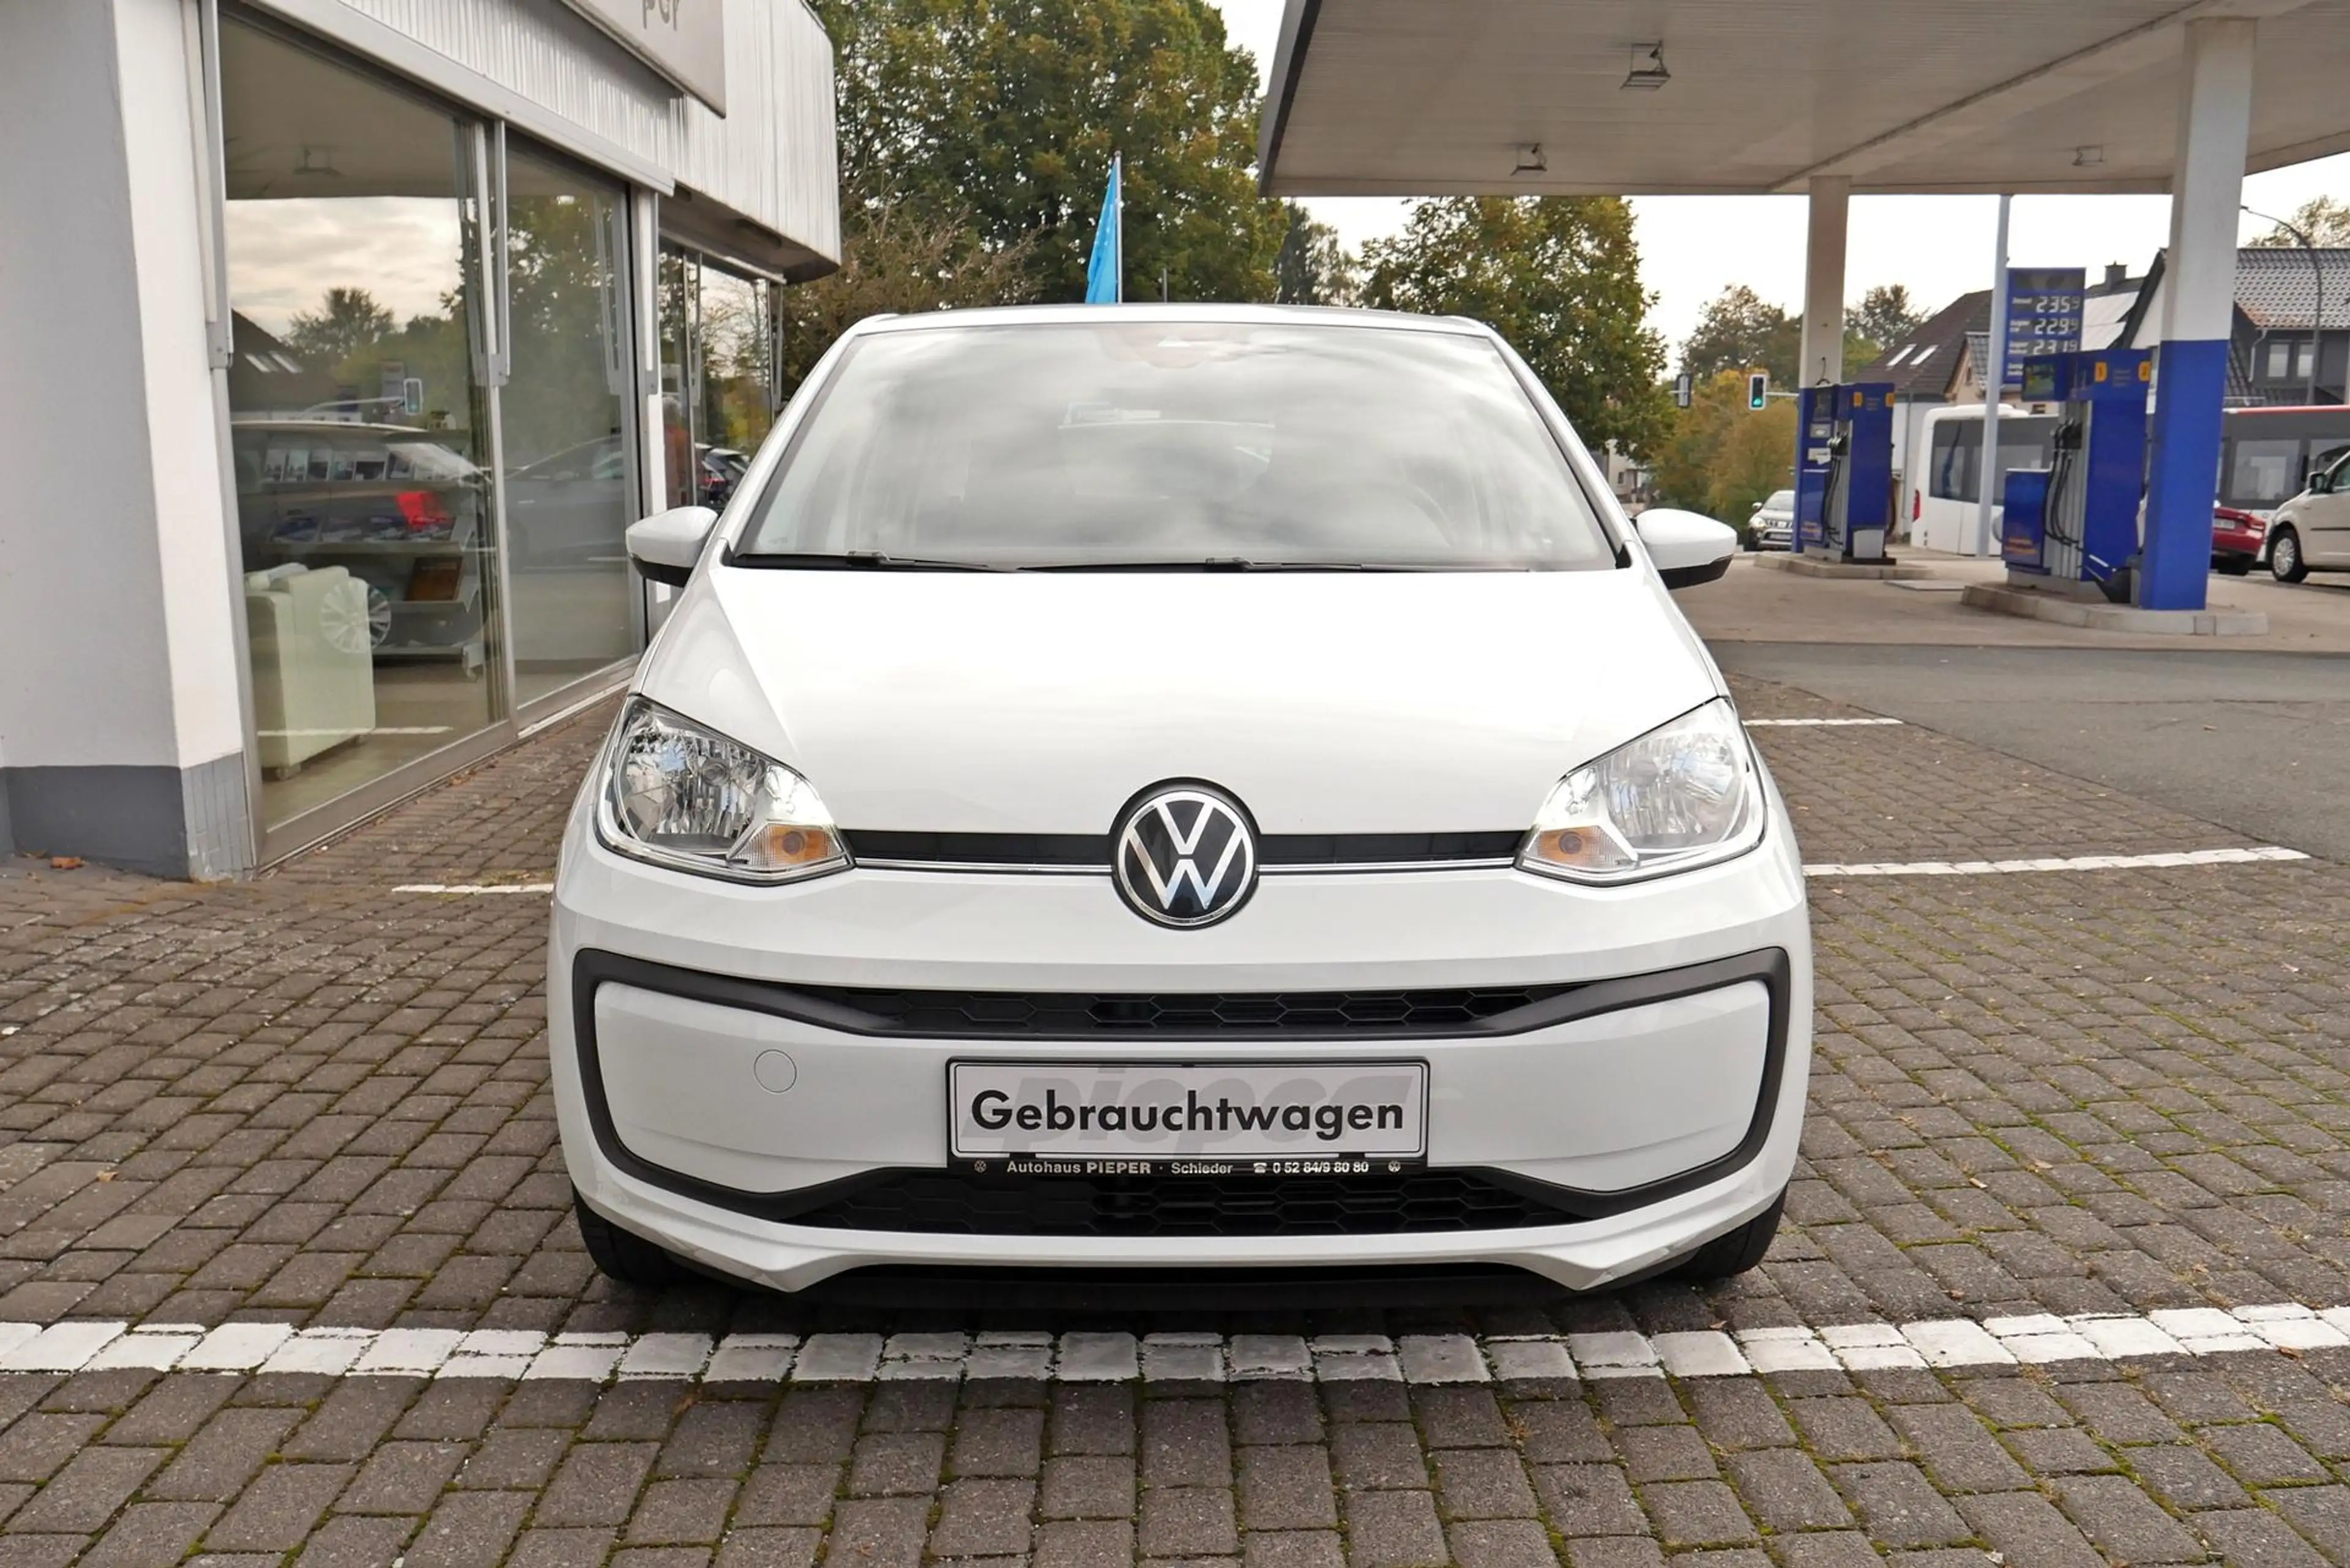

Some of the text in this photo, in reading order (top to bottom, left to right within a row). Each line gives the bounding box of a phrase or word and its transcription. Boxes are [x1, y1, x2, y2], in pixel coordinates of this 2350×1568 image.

[971, 1089, 1403, 1141] Gebrauchtwagen
[1007, 1161, 1081, 1173] Autohaus
[1086, 1162, 1151, 1174] PIEPER
[1171, 1162, 1233, 1174] Schieder
[1285, 1162, 1300, 1173] 52
